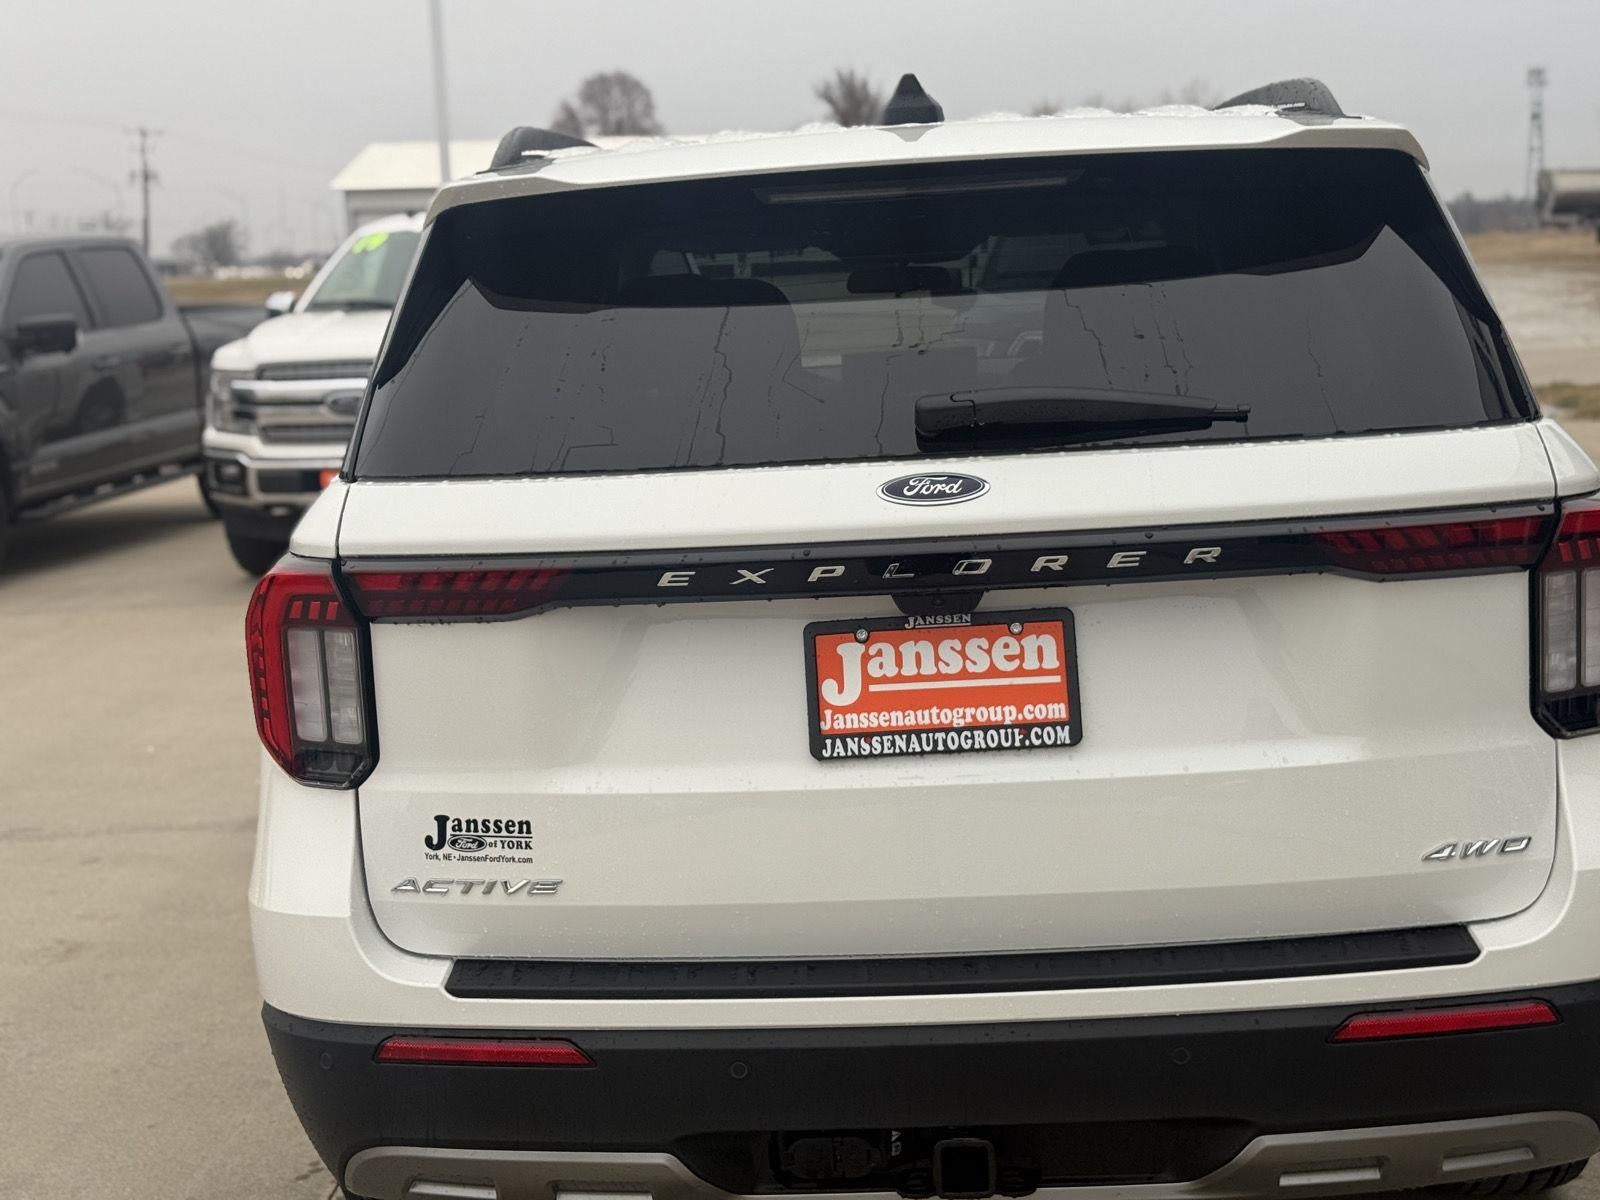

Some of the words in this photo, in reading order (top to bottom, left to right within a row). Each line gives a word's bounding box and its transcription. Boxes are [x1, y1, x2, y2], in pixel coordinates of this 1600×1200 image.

[903, 476, 963, 496] Ford
[657, 546, 1222, 588] EXPLORER
[904, 613, 972, 630] JANSSEN
[821, 632, 1060, 707] Janssen
[820, 702, 1067, 732] Janssenautogroup.com
[424, 814, 533, 851] Janssen
[488, 840, 498, 848] of
[500, 840, 533, 850] YORK
[1420, 836, 1532, 861] 4WD
[424, 852, 441, 862] York,
[443, 853, 453, 861] NE
[456, 853, 533, 864] JanssenFordYork.com
[390, 877, 564, 896] ACTIVE
